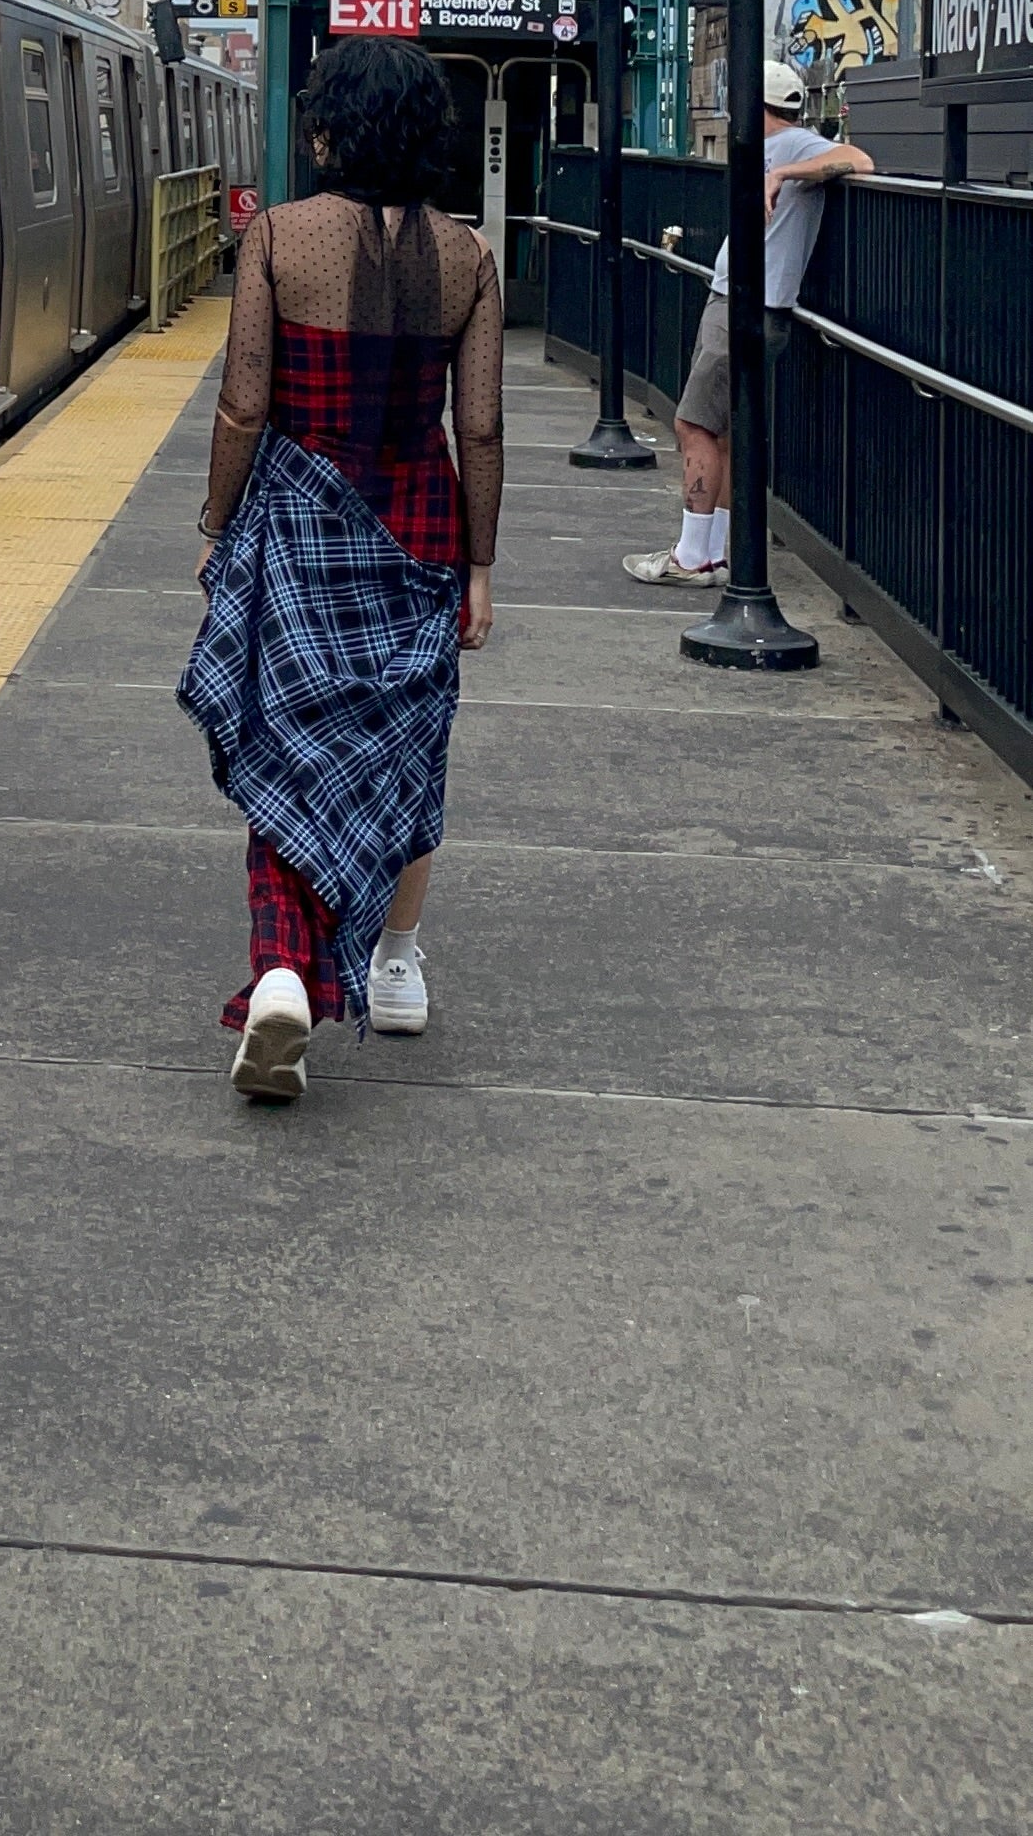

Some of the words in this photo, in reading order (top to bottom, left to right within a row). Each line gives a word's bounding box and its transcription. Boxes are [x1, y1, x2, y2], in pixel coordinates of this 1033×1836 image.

[228, 2, 239, 13] S
[419, 9, 432, 25] &
[439, 10, 523, 31] Broadway
